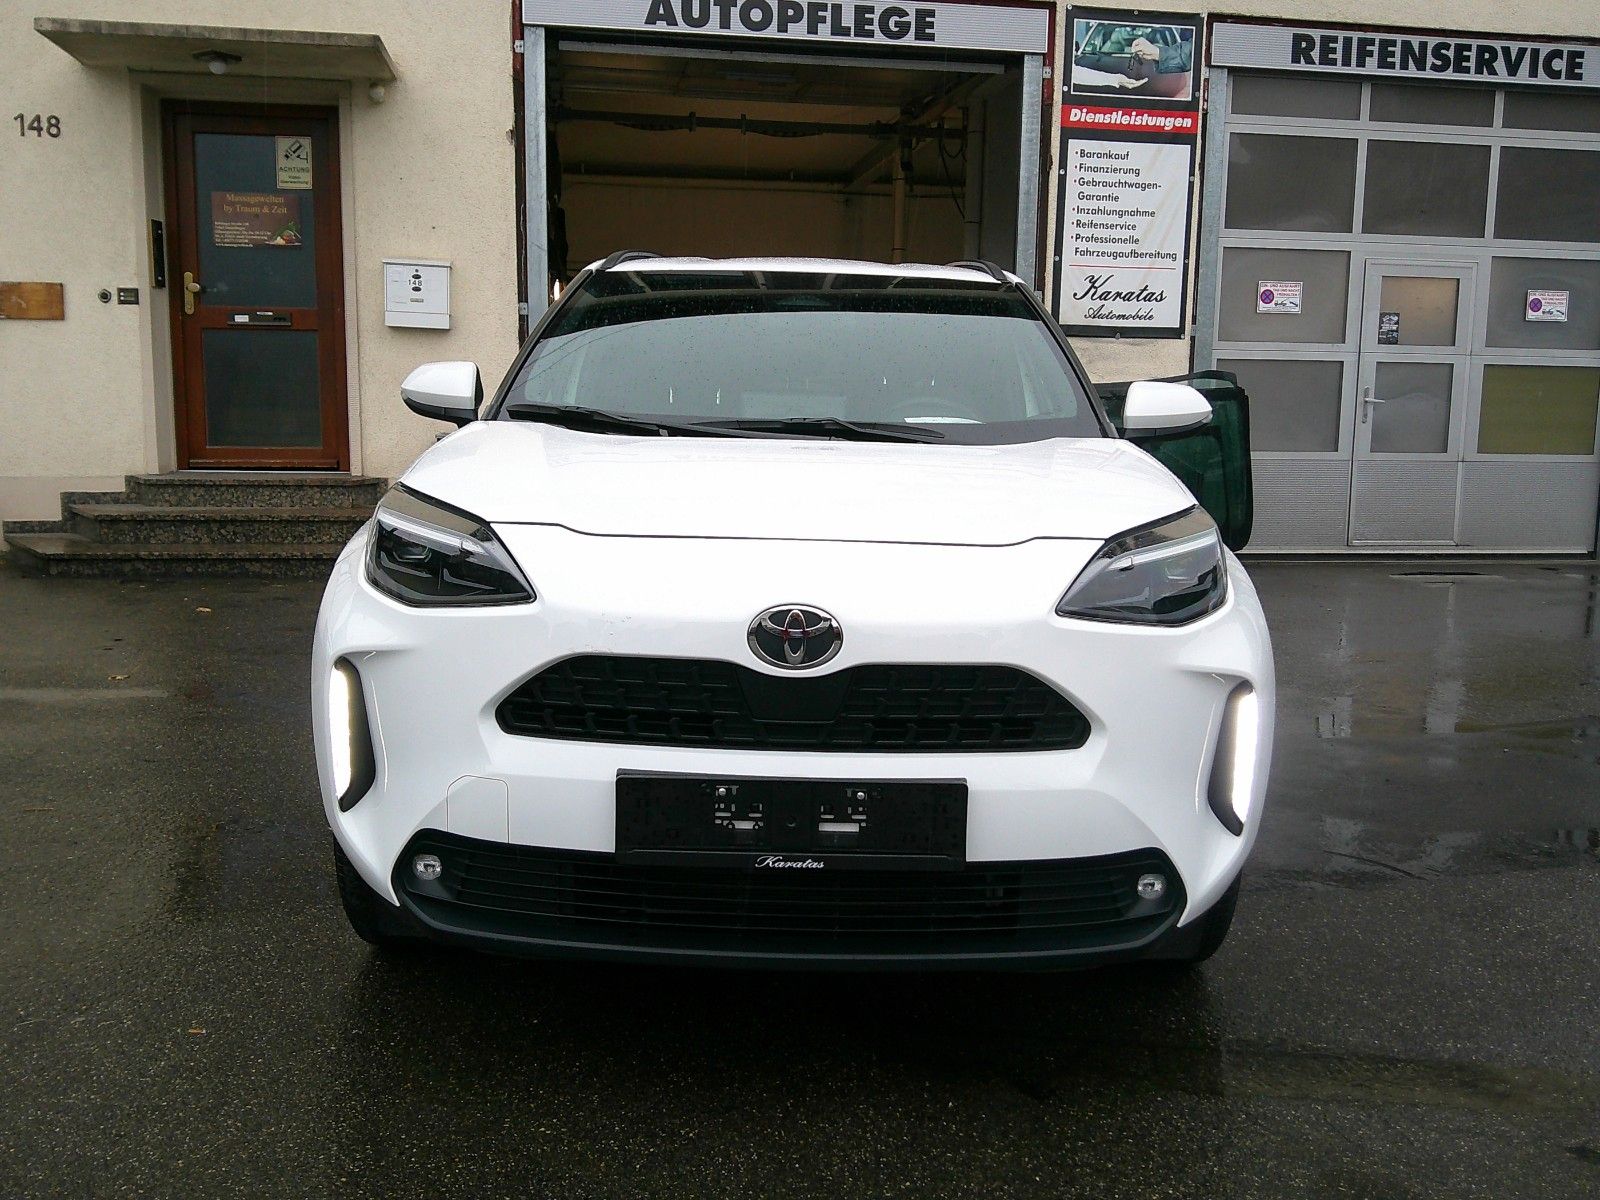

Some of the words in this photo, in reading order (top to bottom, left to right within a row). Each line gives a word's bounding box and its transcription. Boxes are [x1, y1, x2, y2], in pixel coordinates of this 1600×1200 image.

[644, 0, 936, 42] AUTOPFLEGE
[1291, 32, 1585, 81] REIFENSERVICE
[13, 113, 61, 138] 148
[1069, 108, 1192, 130] Dienstleistungen
[1080, 149, 1130, 160] Barankauf
[1079, 163, 1141, 177] Finanzierung
[1078, 177, 1162, 191] Gebrauchtwagen-
[1077, 191, 1120, 202] Garantie
[262, 206, 270, 214] &
[1076, 205, 1156, 218] Inzahlungnahme
[1075, 219, 1137, 231] Reifenservice
[1075, 233, 1140, 245] Professionelle
[1074, 247, 1178, 261] Fahrzeugaufbereitung
[1073, 274, 1168, 303] Karatas
[1084, 304, 1155, 321] Automobile
[755, 855, 825, 869] Karatas
